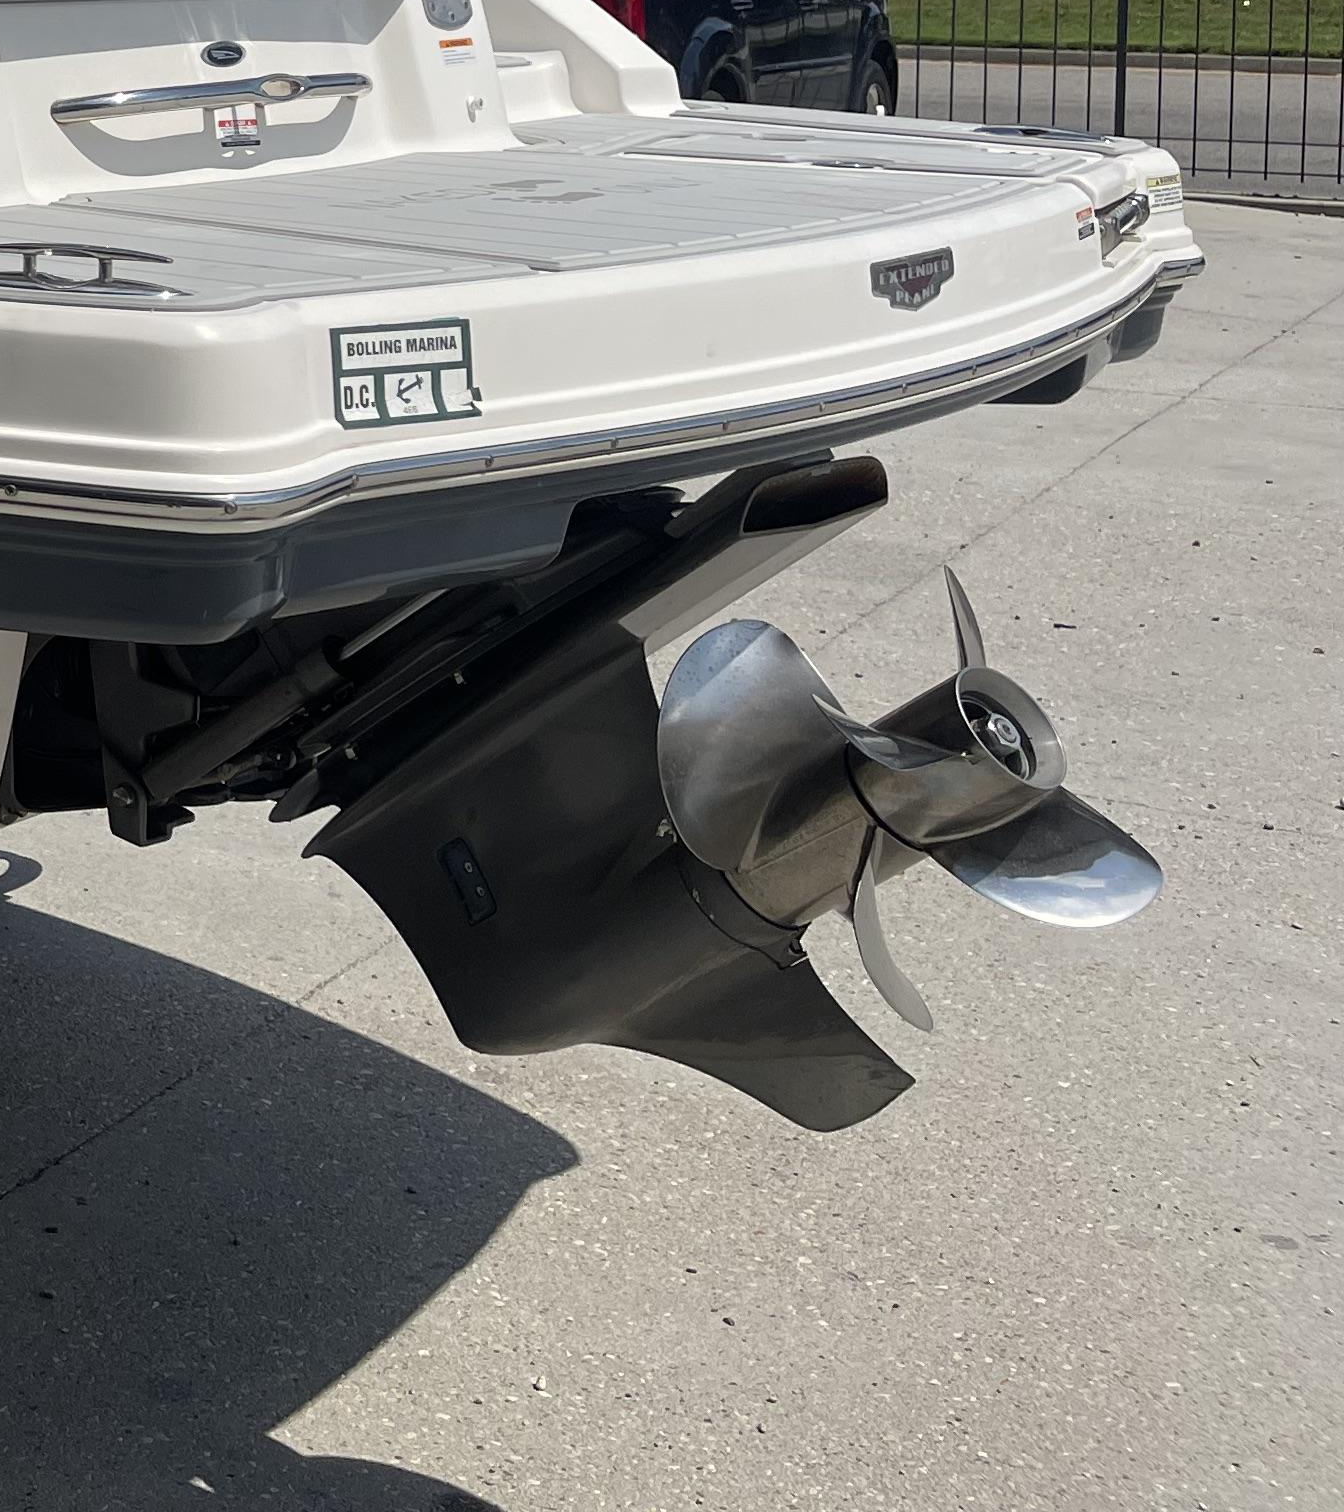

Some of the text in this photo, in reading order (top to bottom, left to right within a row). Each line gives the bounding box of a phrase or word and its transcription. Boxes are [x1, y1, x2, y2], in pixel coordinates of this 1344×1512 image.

[879, 259, 950, 286] EXTENDED
[346, 335, 458, 357] BOLLING MARINA
[343, 384, 377, 410] D.C.
